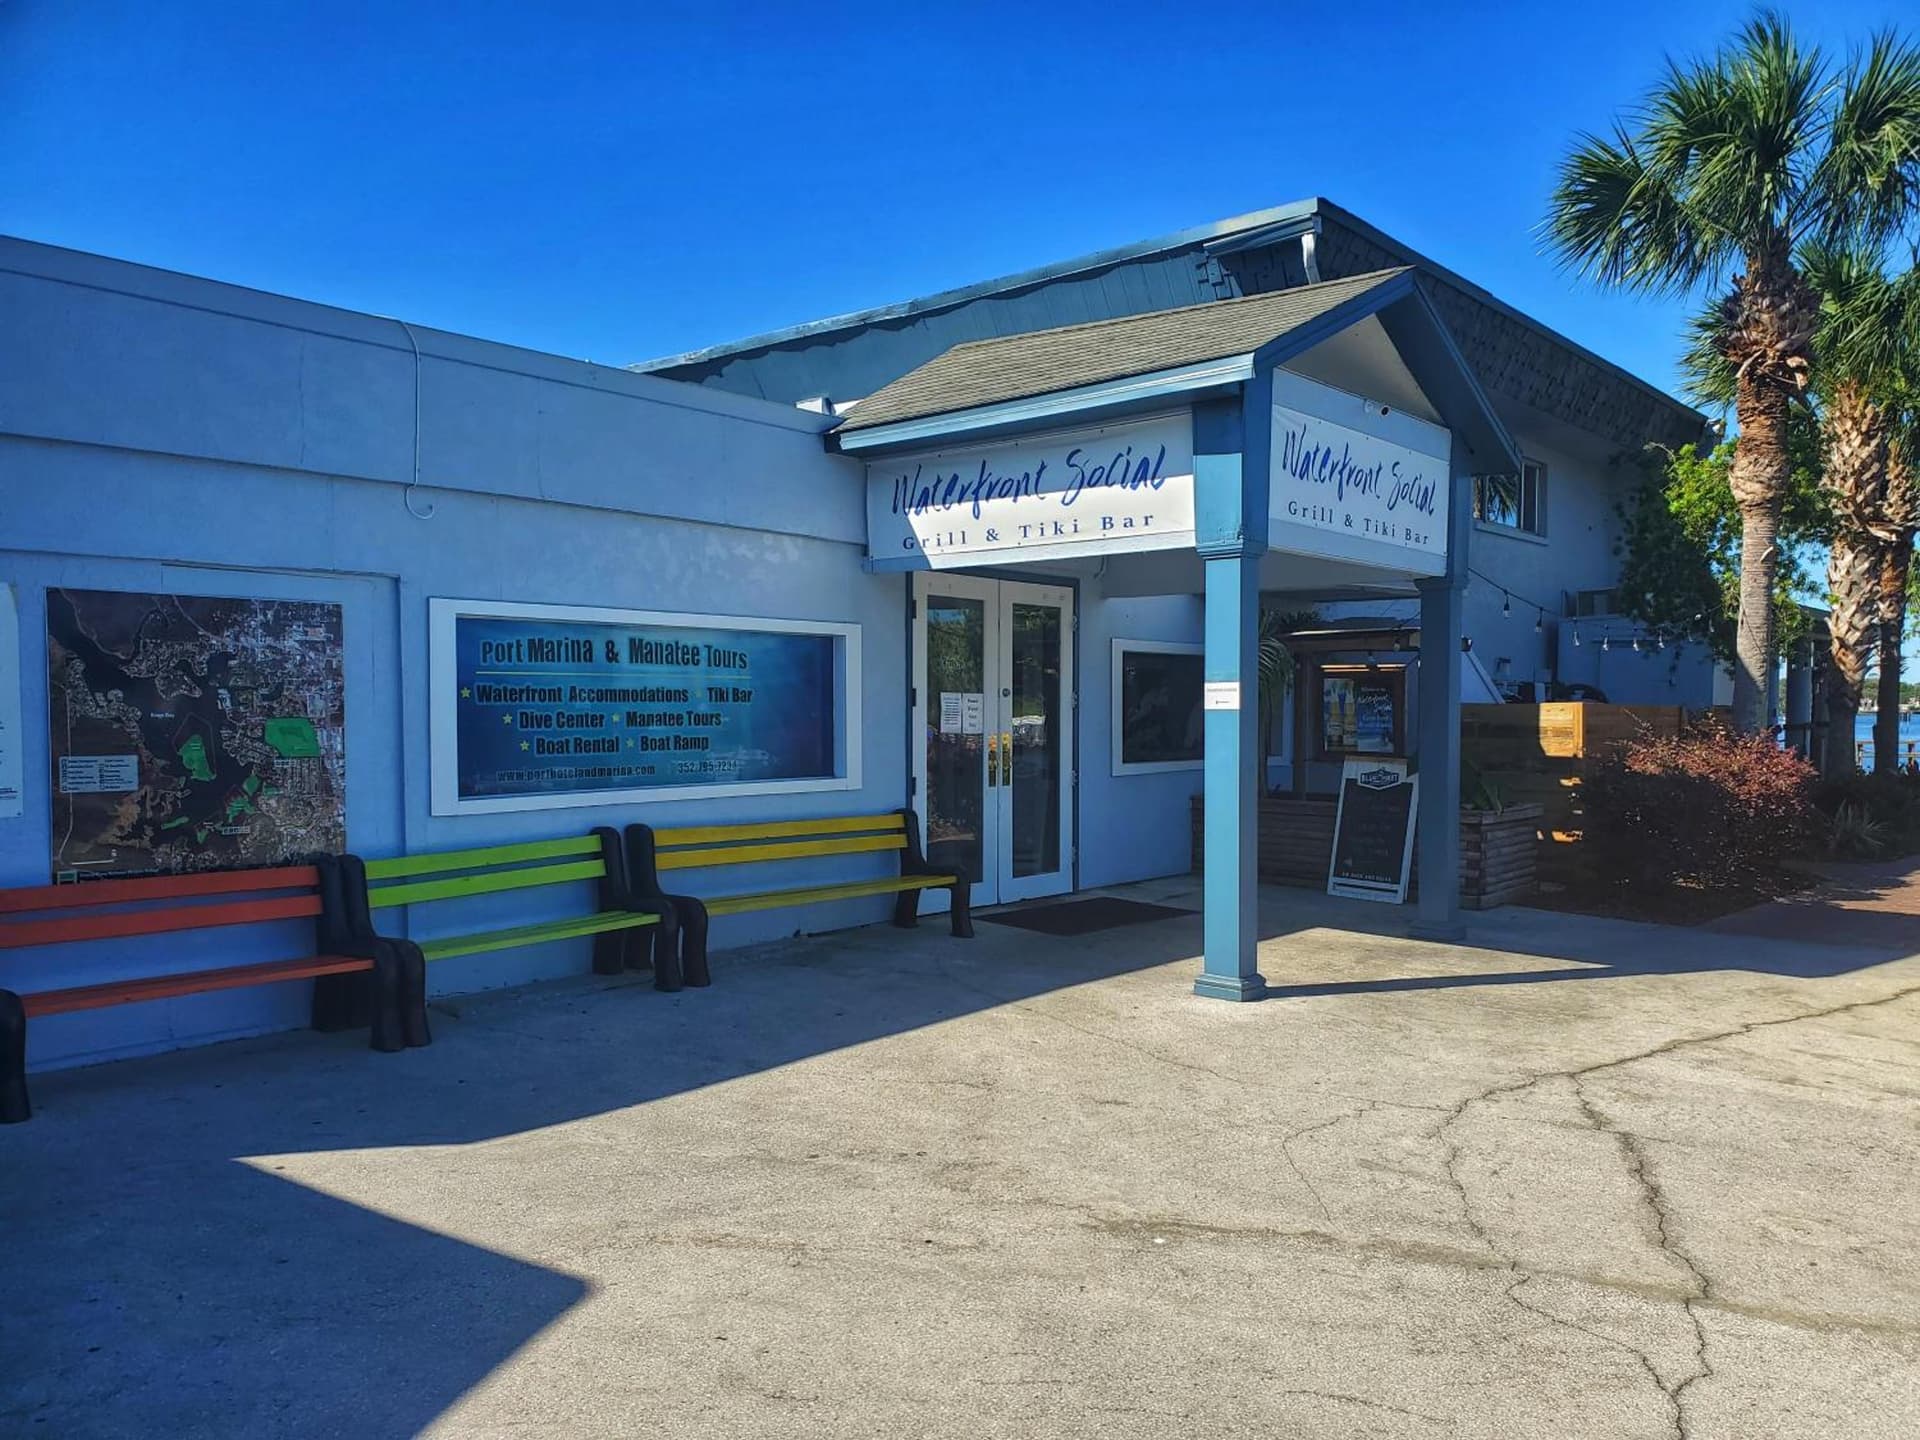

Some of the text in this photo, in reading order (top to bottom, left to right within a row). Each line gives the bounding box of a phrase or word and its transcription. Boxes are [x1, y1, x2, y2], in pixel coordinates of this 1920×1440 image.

[892, 443, 1166, 520] Waterfront Social
[1283, 423, 1435, 517] Waterfront Social
[903, 514, 1154, 550] Grill & Tiki Bar
[1288, 501, 1430, 545] Grill & Tiki Bar
[481, 636, 747, 669] Port Marina & Manatee Tours
[476, 684, 752, 703] Waterfront Accommodations Tiki Bar
[519, 710, 722, 729] Dive Center Manatee Tours
[536, 735, 709, 755] Boat Rental Boat Ramp
